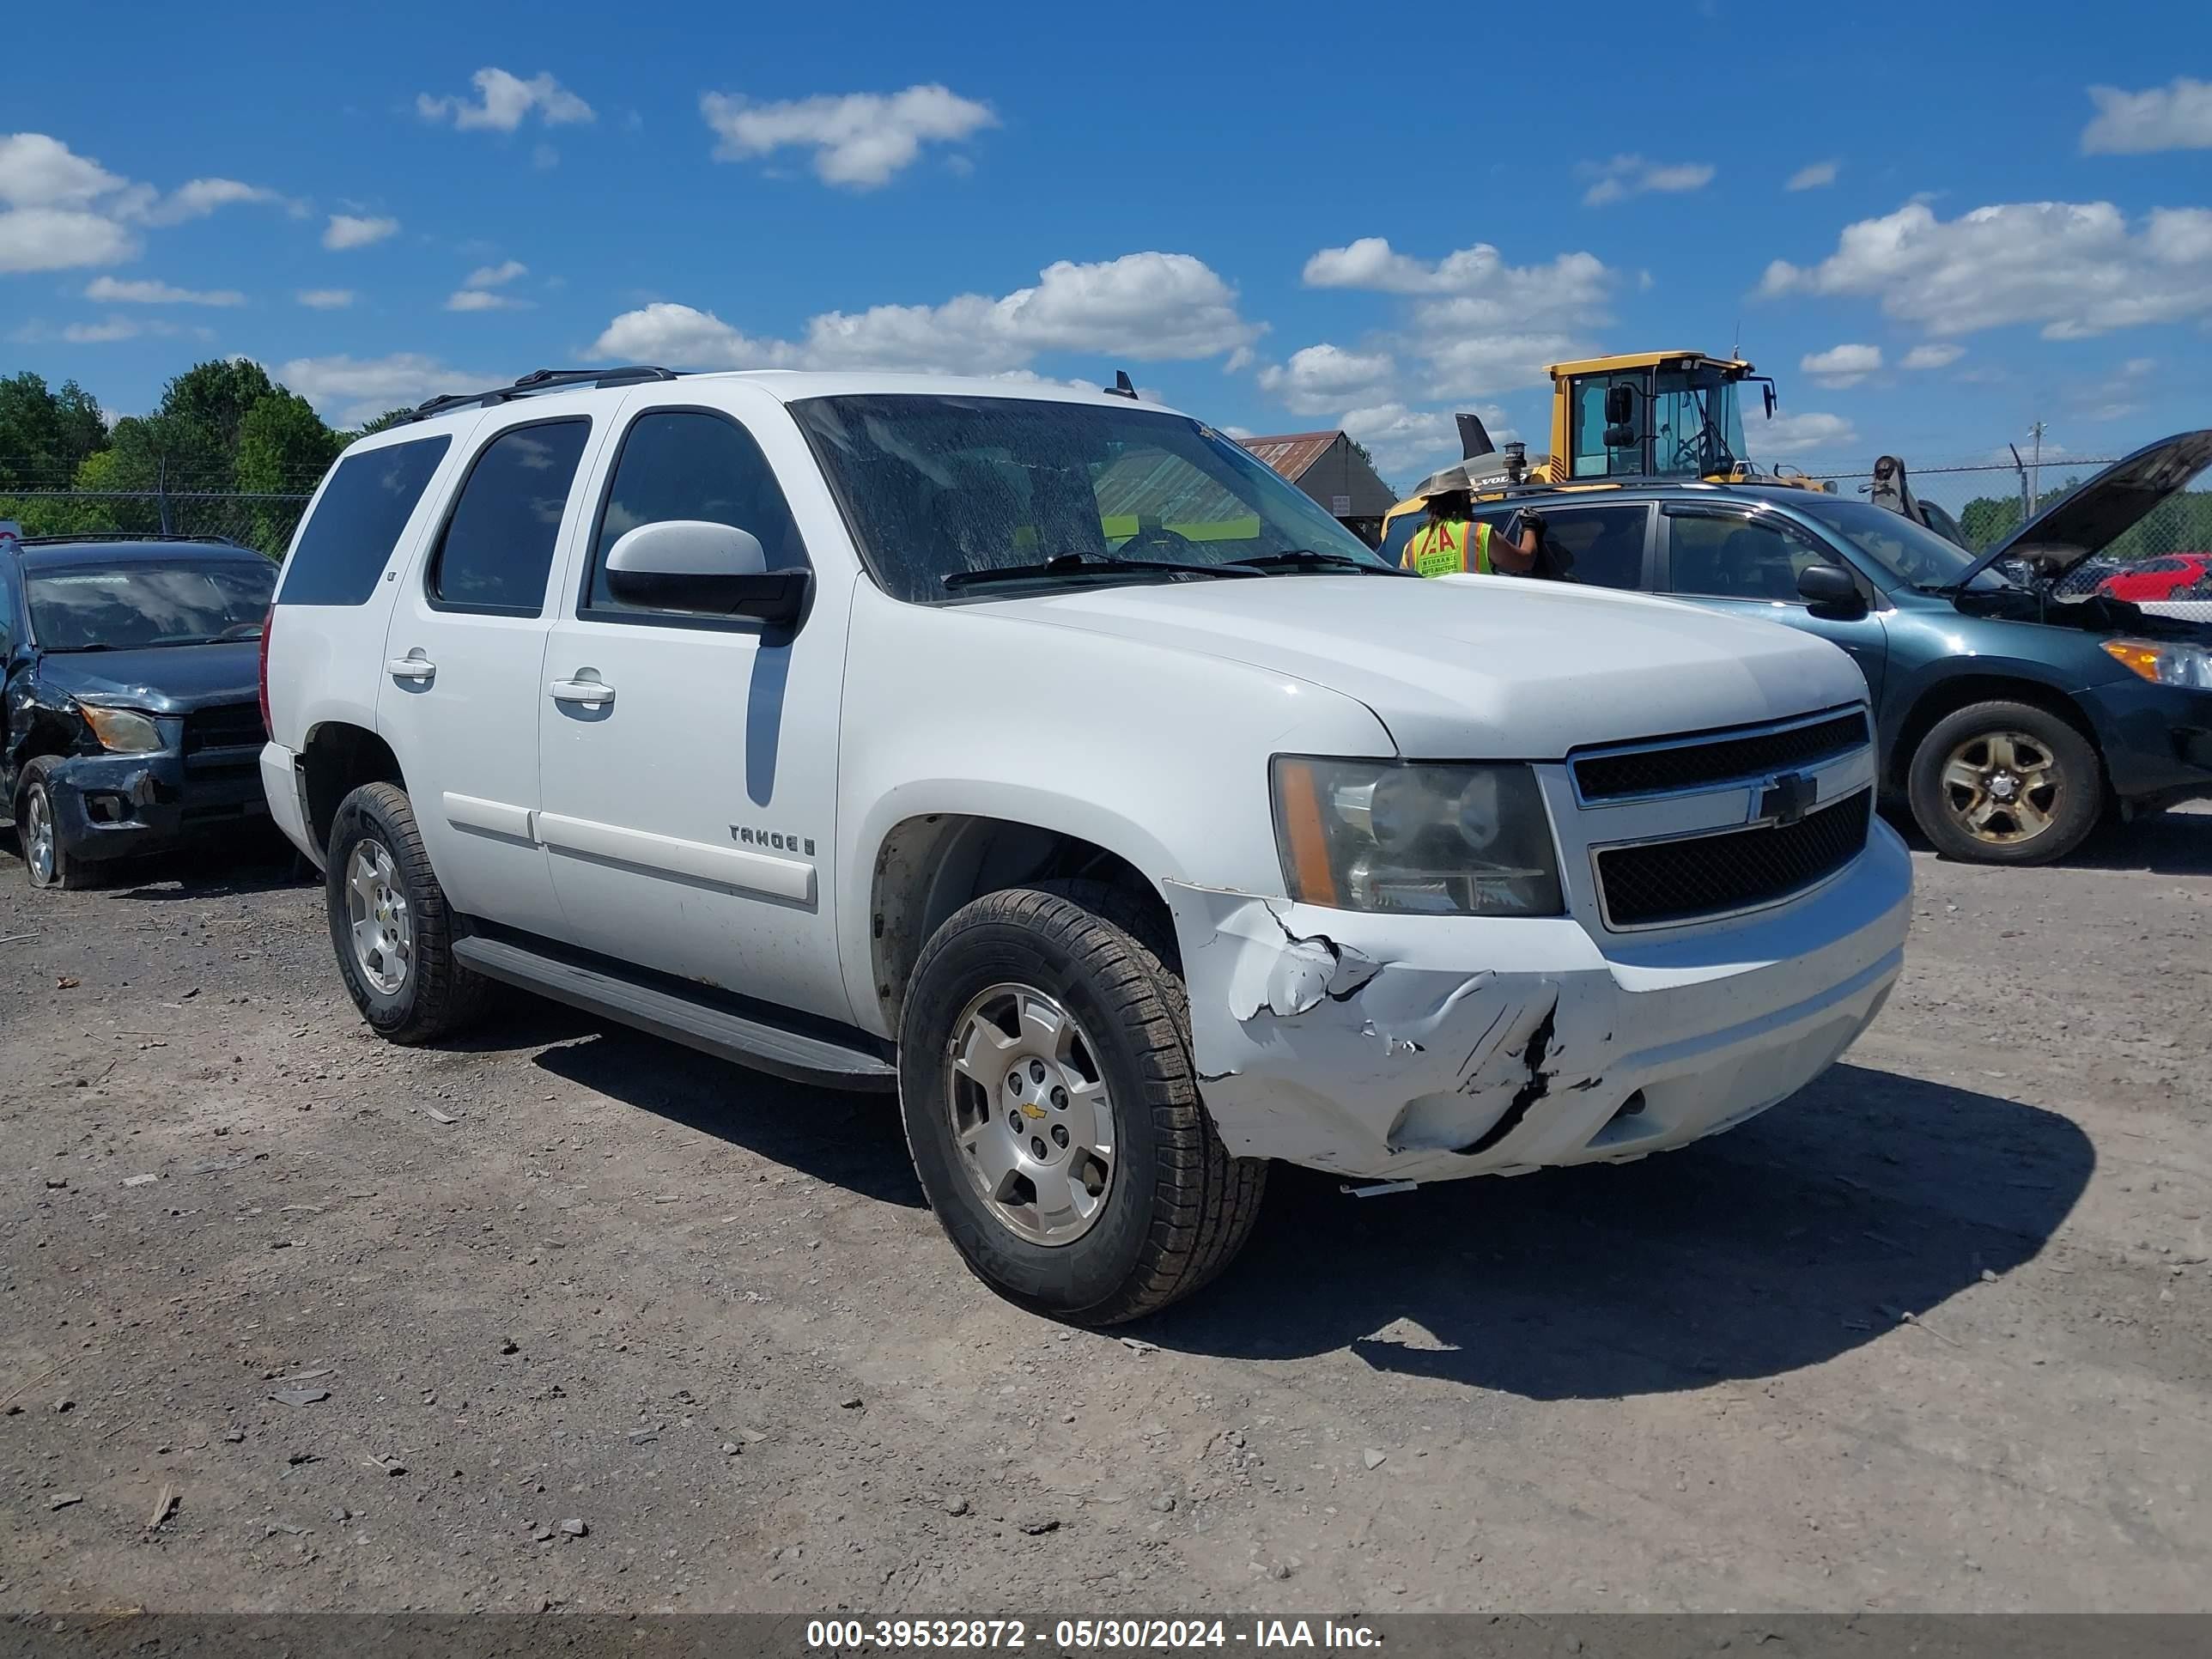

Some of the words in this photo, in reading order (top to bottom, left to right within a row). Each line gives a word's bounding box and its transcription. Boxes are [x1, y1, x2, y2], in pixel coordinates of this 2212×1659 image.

[1481, 472, 1528, 485] VOLO
[1420, 555, 1457, 567] INSURANCE
[1421, 567, 1434, 575] AUTO
[729, 824, 799, 853] TAHOE
